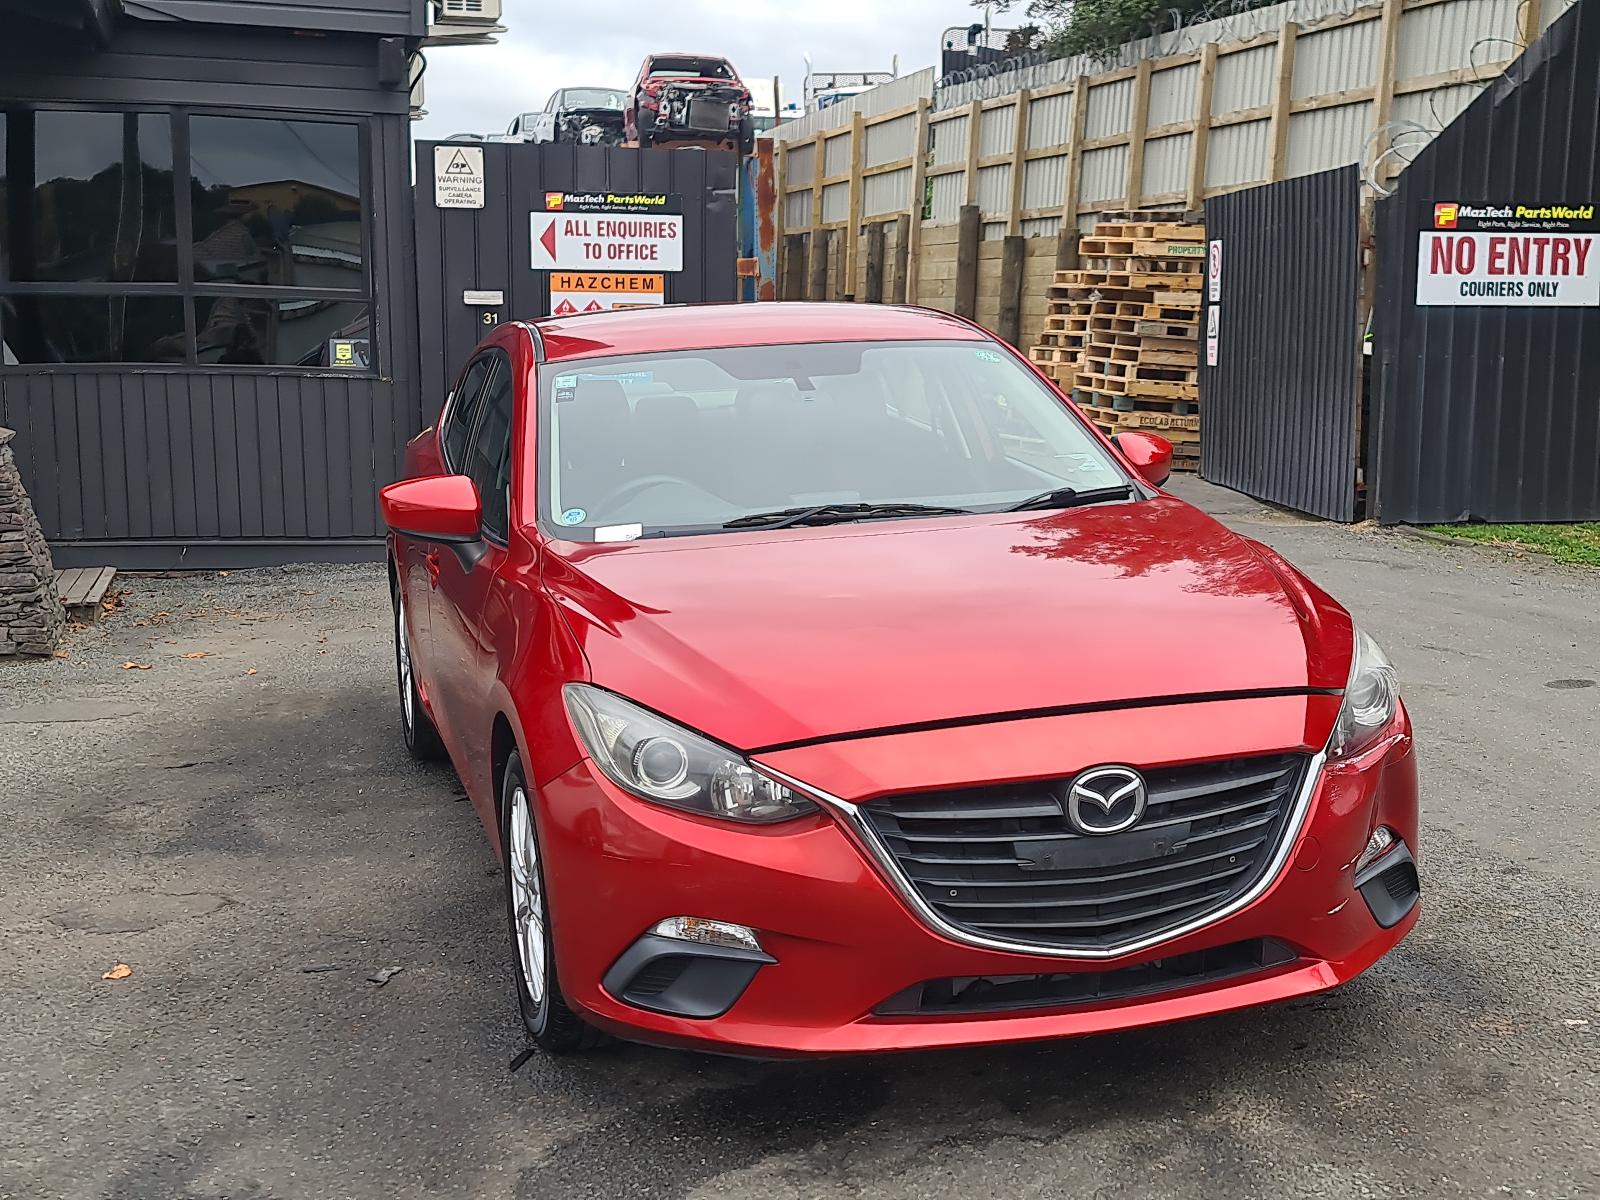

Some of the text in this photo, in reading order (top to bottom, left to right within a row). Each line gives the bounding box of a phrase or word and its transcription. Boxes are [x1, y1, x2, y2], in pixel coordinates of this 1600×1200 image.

[437, 176, 482, 184] WARNING
[564, 194, 666, 205] MazTech PartsWorld
[1458, 206, 1594, 219] MazTech PartsWorld
[564, 220, 677, 239] ALL ENQUIRIES
[584, 243, 658, 260] TO OFFICE
[1430, 236, 1592, 276] NO ENTRY
[561, 276, 654, 290] HAZCHEM
[1460, 281, 1559, 297] COURIERS ONLY
[483, 312, 498, 324] 31
[1140, 416, 1169, 426] ECOLAB
